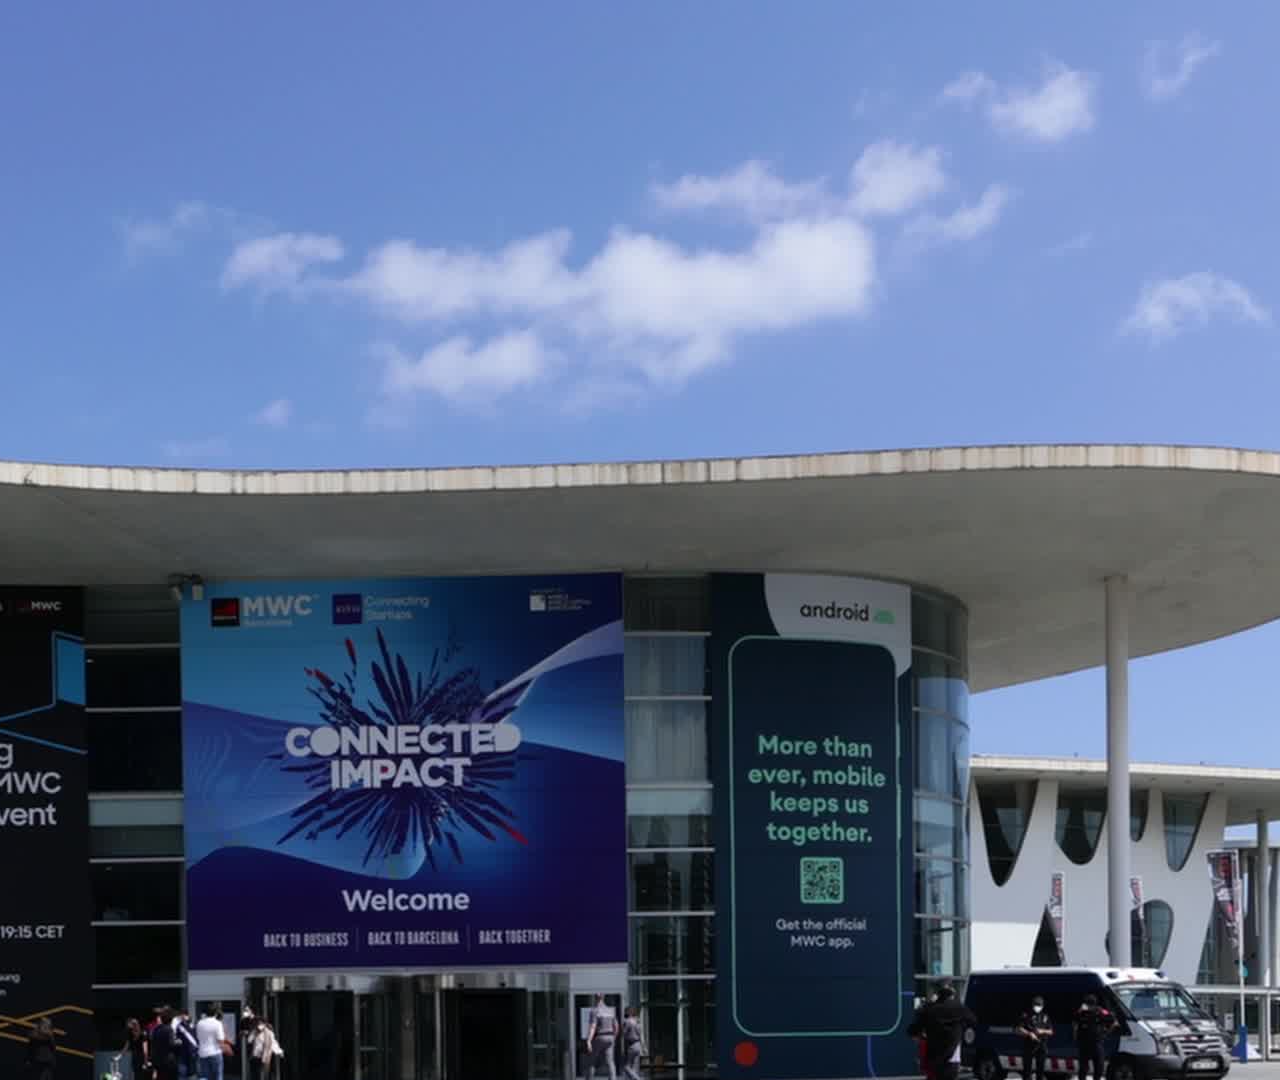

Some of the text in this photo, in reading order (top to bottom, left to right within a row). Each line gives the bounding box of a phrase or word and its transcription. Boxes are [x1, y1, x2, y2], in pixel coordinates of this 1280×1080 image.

[31, 601, 62, 611] MWC
[242, 594, 313, 617] MWC
[800, 602, 869, 622] android
[285, 723, 521, 757] CONNECTED
[758, 736, 872, 758] More than
[330, 756, 472, 790] IMPACT
[748, 766, 886, 788] ever, mobile
[770, 792, 869, 815] keeps us
[767, 821, 873, 846] together.
[341, 888, 470, 912] Welcome
[0, 925, 33, 939] 19:15
[35, 925, 65, 939] CET
[776, 918, 867, 932] Get the official
[263, 929, 551, 948] BACK TO BUSINESS BACK TO BARCELONA BACK TOGETHER
[790, 936, 855, 950] MWC app.
